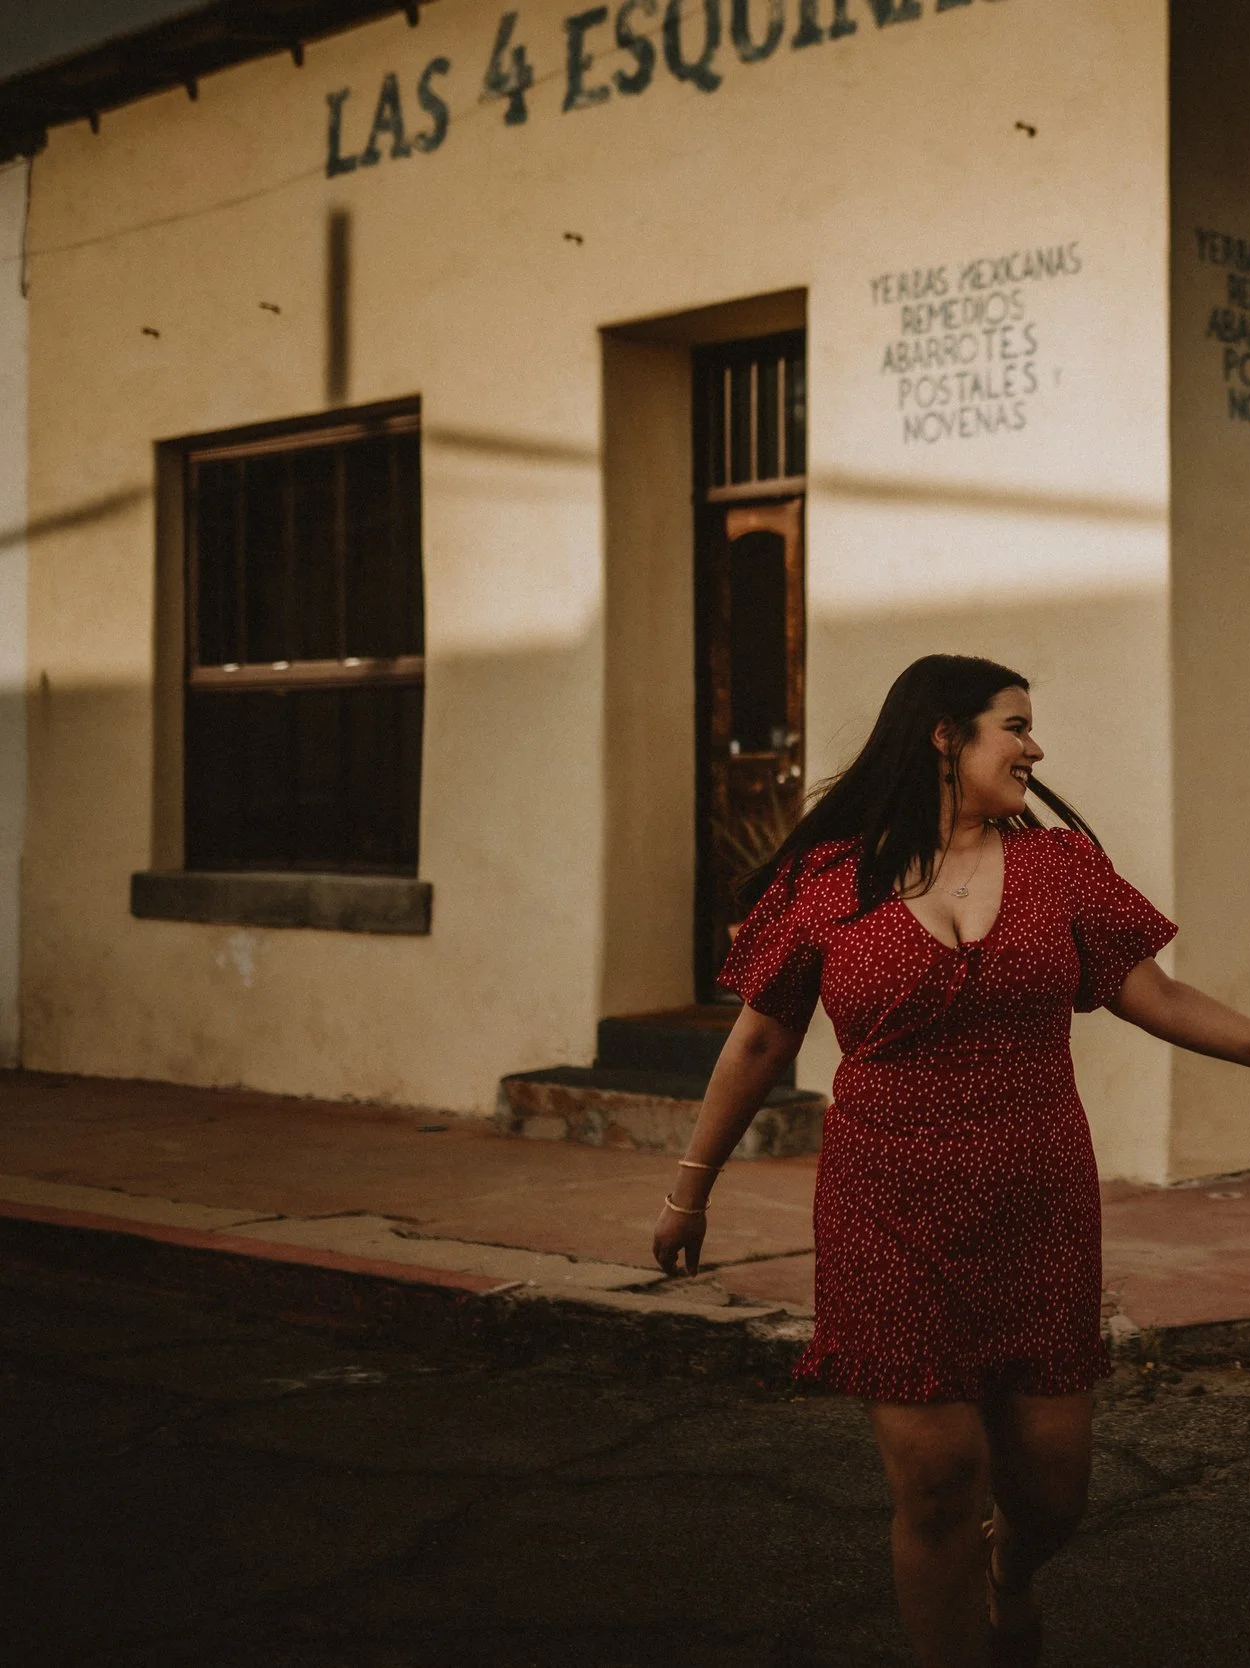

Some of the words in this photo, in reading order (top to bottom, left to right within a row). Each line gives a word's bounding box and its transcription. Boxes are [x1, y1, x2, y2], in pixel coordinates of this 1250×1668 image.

[325, 56, 451, 179] LAS
[477, 11, 533, 126] 4
[562, 0, 1007, 113] ESQU
[957, 241, 1082, 293] MEXICANAS
[901, 287, 1025, 337] REMEDIOS
[882, 322, 1039, 374] ABARROTES
[900, 360, 1039, 410] POSTALES
[903, 401, 1028, 446] NOVENAS
